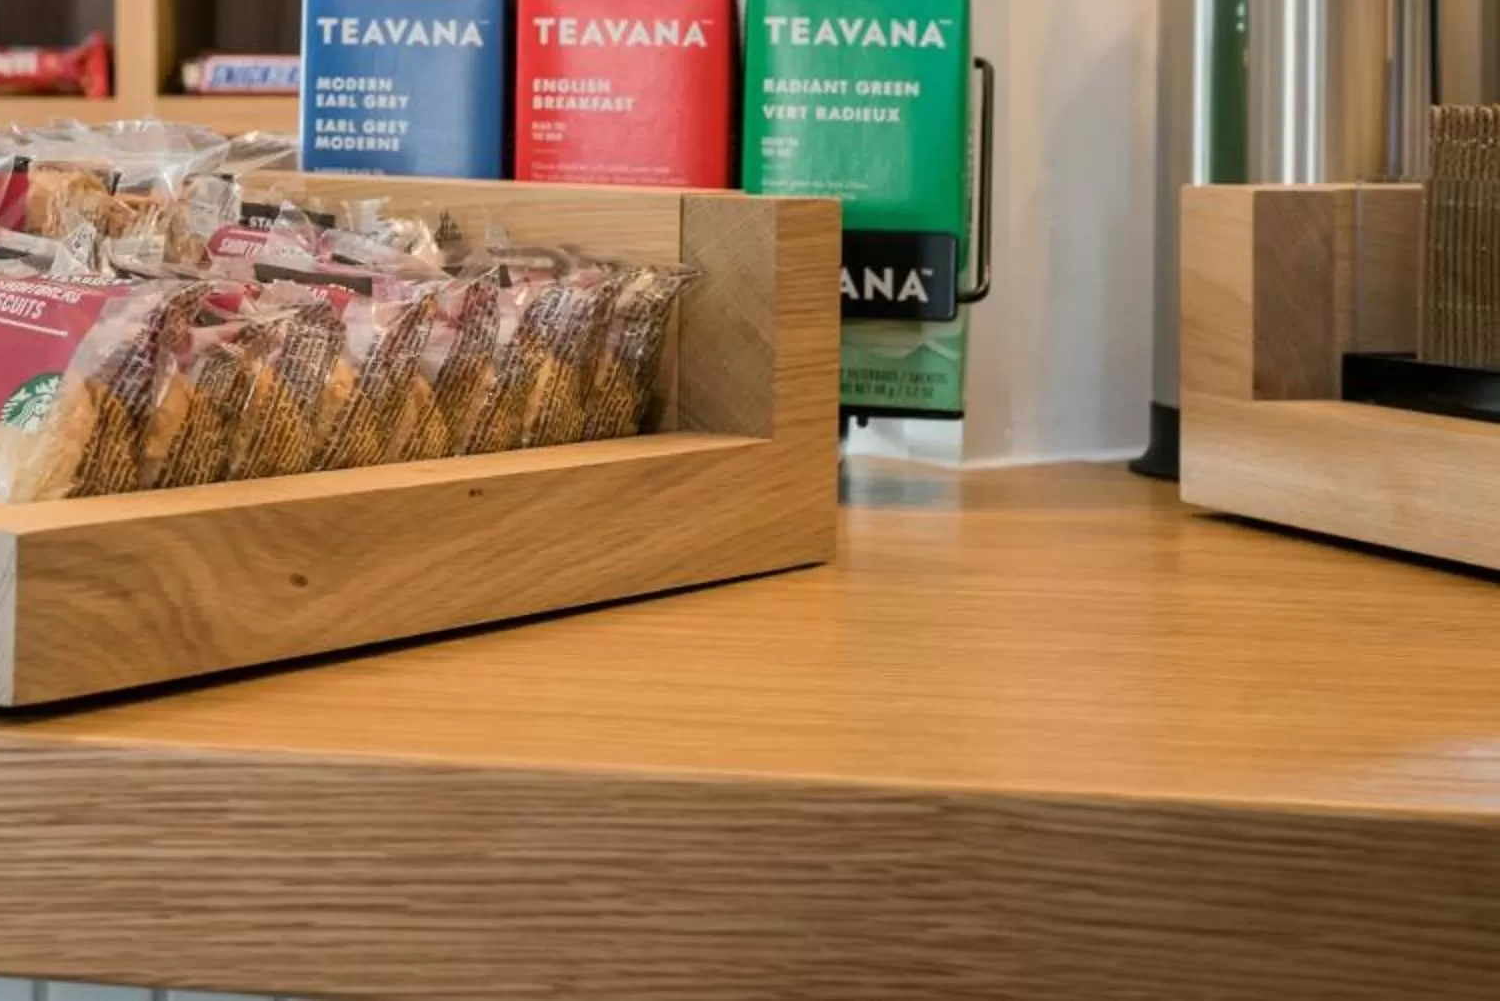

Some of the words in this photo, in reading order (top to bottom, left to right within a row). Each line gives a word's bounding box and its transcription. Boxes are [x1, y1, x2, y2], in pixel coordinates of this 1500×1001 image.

[316, 17, 484, 46] TEAVANA
[533, 17, 708, 47] TEAVANA
[764, 17, 946, 48] TEAVANA
[316, 76, 393, 92] MODERN
[533, 78, 611, 93] ENGLISH
[763, 79, 848, 95] RADIANT
[855, 80, 920, 97] GREEN
[316, 94, 357, 108] EARL
[363, 96, 409, 109] GREY
[532, 95, 635, 112] BREAKFAST
[762, 104, 808, 120] VERT
[816, 106, 901, 122] RADIEUX
[315, 118, 357, 133] EARL
[363, 119, 409, 135] GREY
[315, 135, 400, 151] MODERNE
